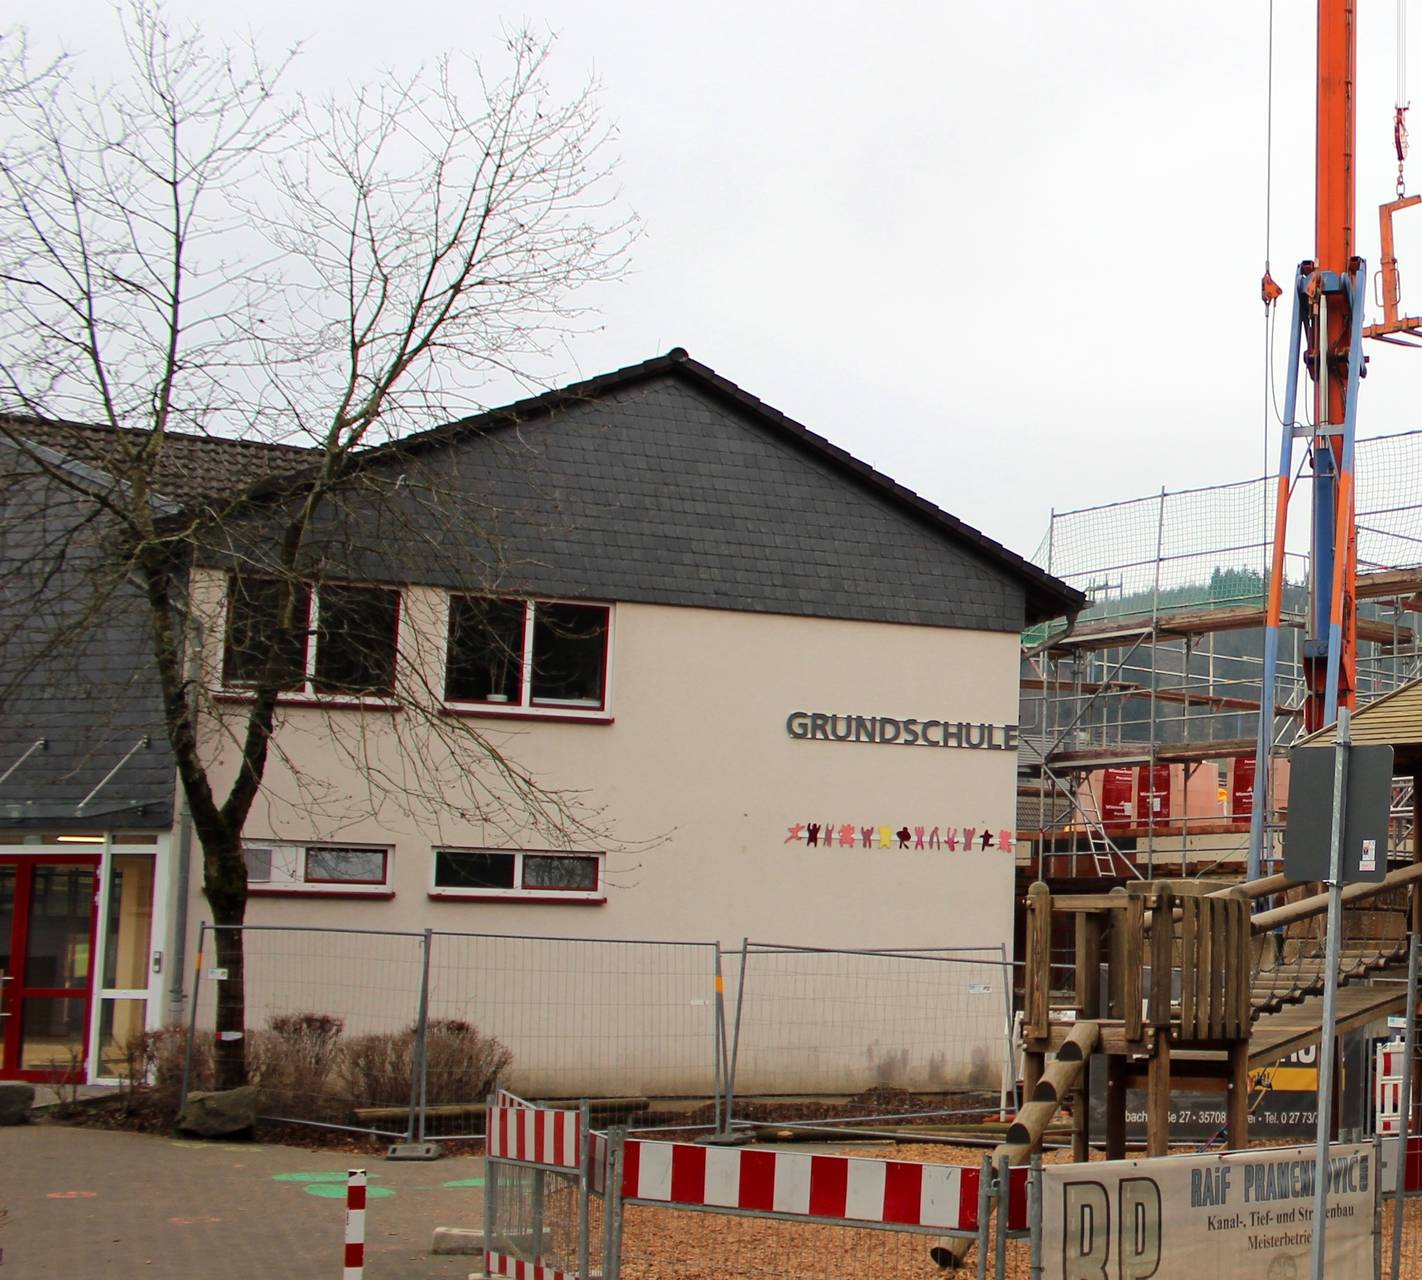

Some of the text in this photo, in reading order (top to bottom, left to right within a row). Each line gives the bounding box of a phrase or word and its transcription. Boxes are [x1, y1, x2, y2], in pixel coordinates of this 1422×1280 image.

[786, 711, 1018, 751] GRUNDSCHULE
[1178, 1111, 1191, 1123] 27
[1198, 1111, 1227, 1124] 35708
[1263, 1111, 1279, 1124] Tel.
[1281, 1111, 1287, 1124] 0
[1288, 1111, 1300, 1124] 27
[1207, 1203, 1354, 1232] Kanal-, Tief- und Strenbau
[1247, 1228, 1314, 1251] Meisterbetrie
